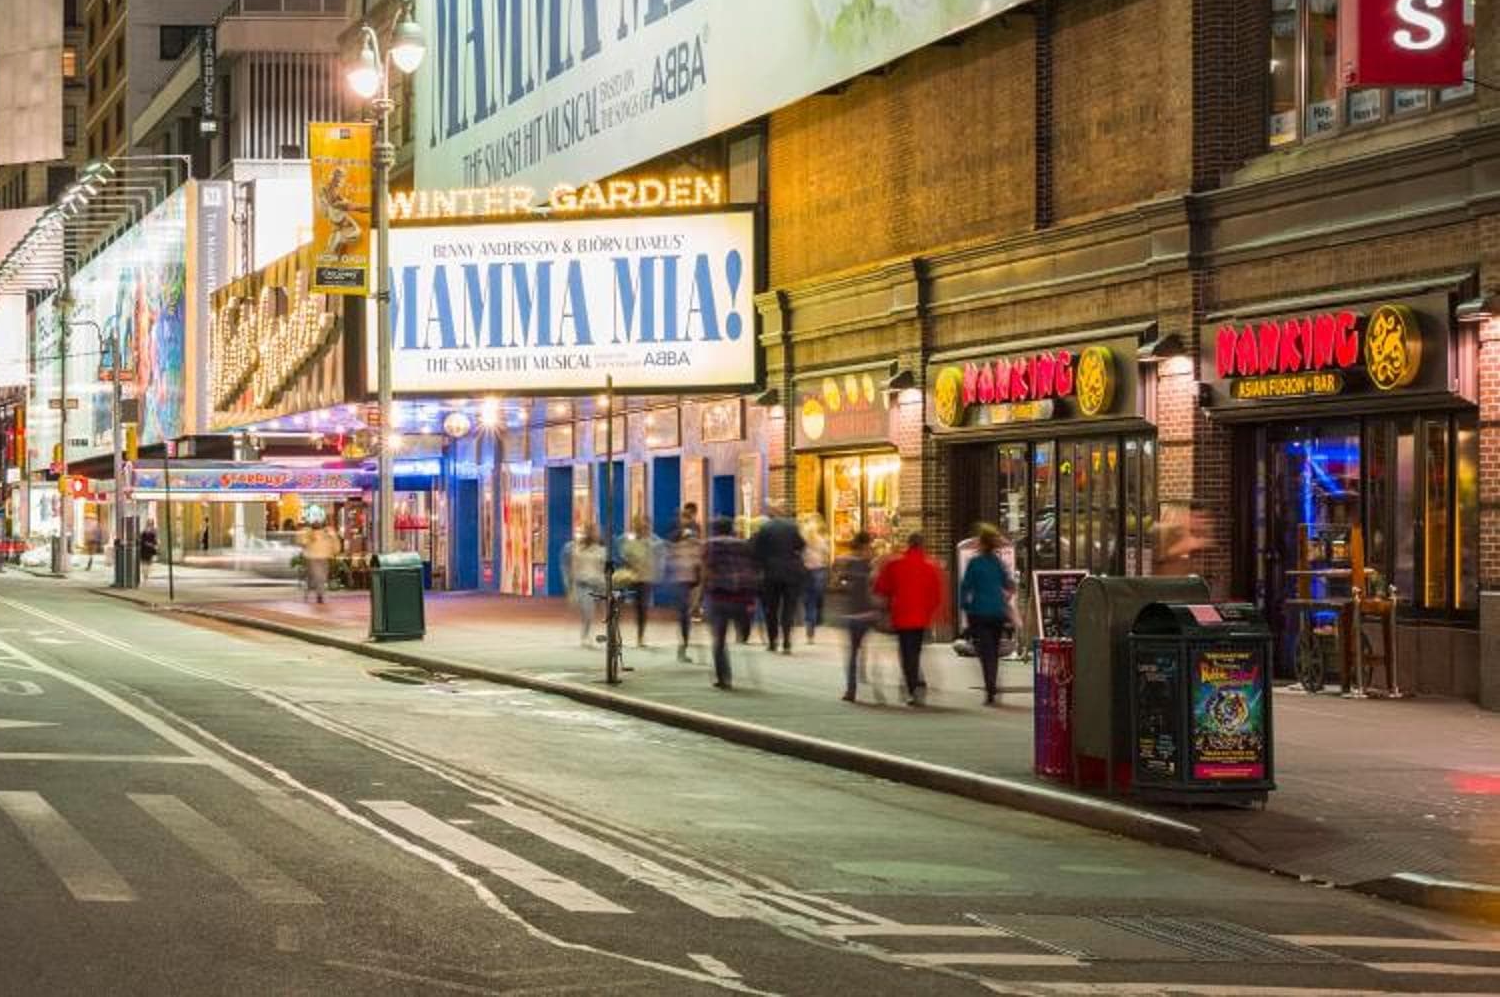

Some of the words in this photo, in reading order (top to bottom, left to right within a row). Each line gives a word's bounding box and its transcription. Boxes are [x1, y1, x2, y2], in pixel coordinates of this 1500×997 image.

[651, 34, 707, 109] ABBA
[485, 130, 522, 187] SMASH
[523, 114, 543, 166] HIT
[544, 88, 600, 157] MUSICAL
[388, 186, 536, 219] WINTER
[549, 176, 722, 211] GARDEN
[433, 242, 474, 258] BENNY
[479, 238, 557, 257] ANDERSSON
[562, 240, 573, 253] &
[577, 235, 623, 252] BJÖRN
[389, 259, 596, 350] MAMMA
[611, 249, 743, 344] MIA!
[426, 357, 449, 374] THE
[455, 356, 501, 373] SMASH
[506, 355, 528, 372] HIT
[533, 353, 592, 371] MUSICAL
[643, 350, 691, 367] ABBA
[1216, 308, 1360, 379] NANKING
[963, 349, 1073, 409] NANKING
[1239, 381, 1267, 399] ASIAN
[1269, 379, 1306, 396] FUSION
[1313, 374, 1335, 395] BAR
